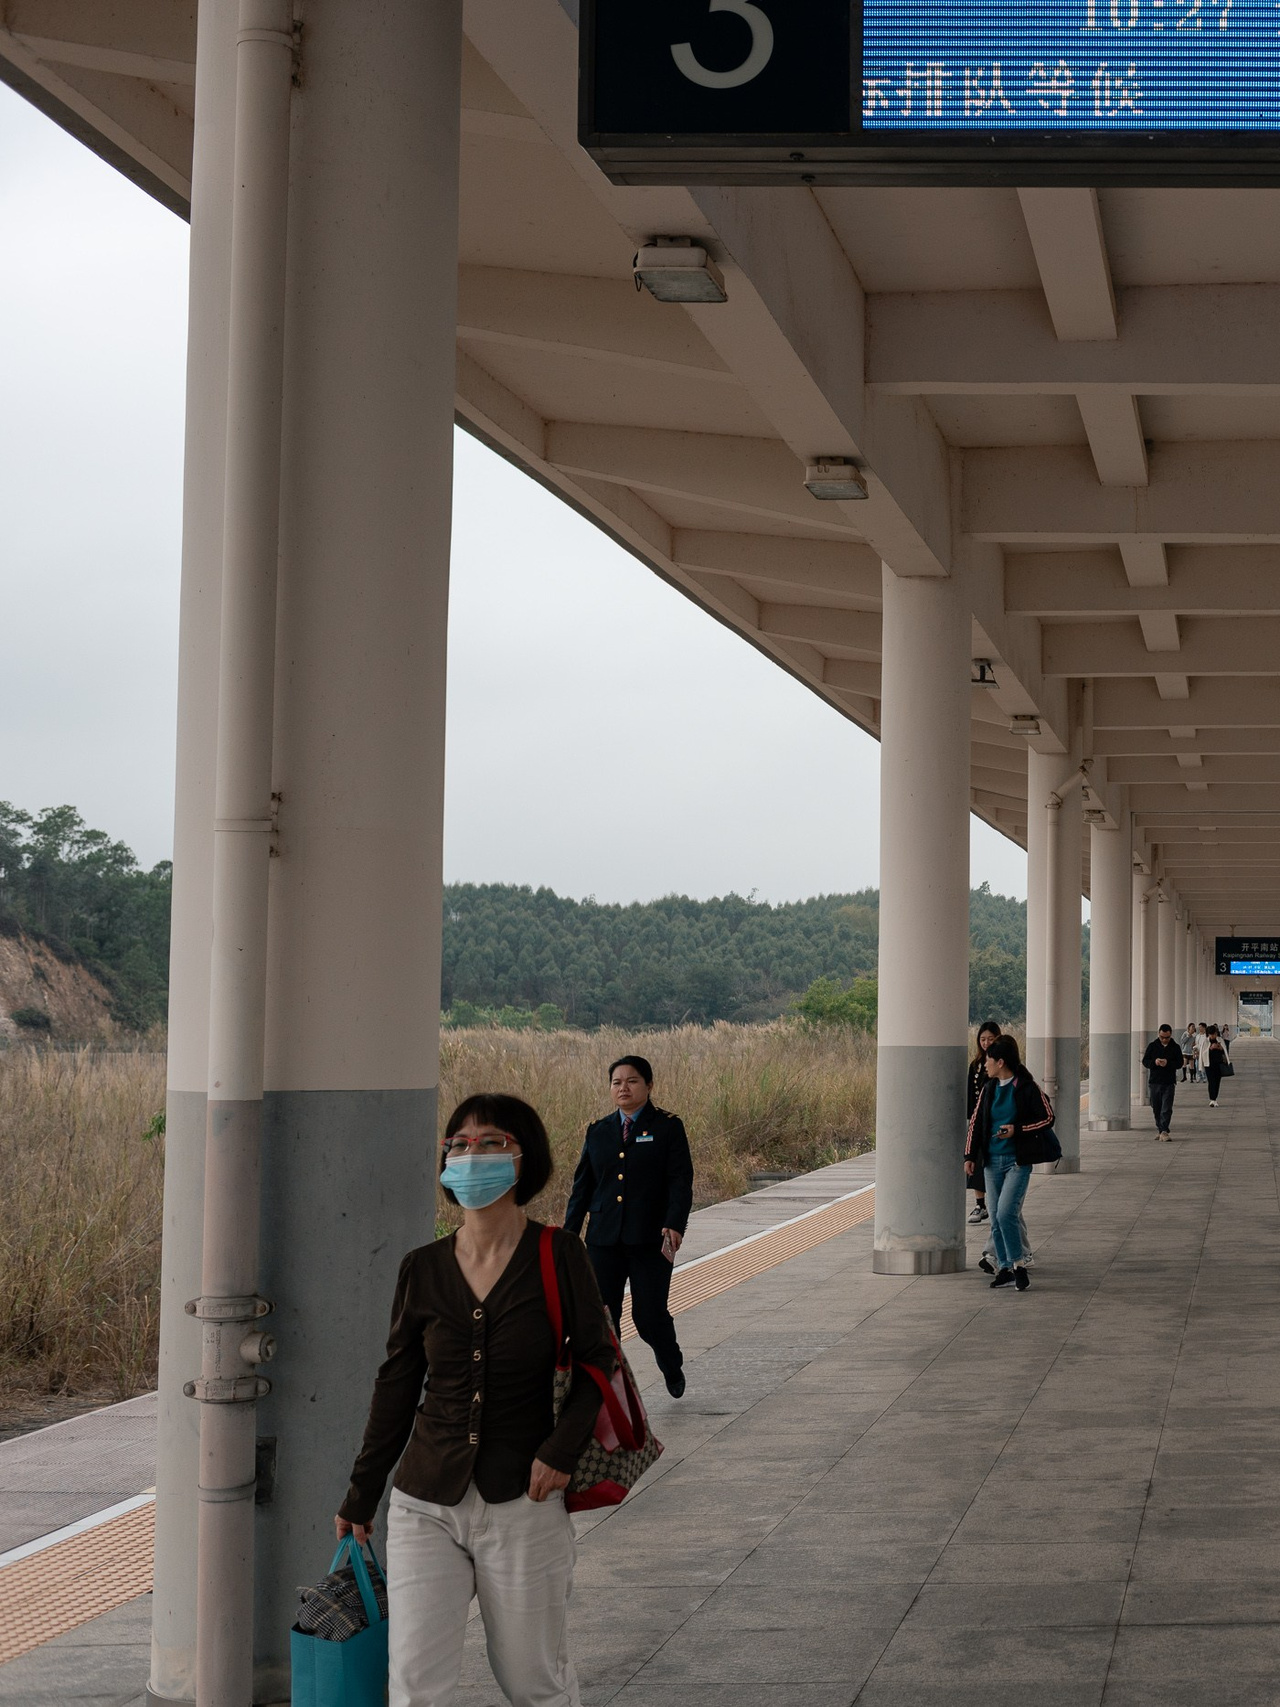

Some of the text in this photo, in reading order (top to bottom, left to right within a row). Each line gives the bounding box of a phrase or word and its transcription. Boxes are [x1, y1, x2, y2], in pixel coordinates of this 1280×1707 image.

[670, 0, 774, 89] 3
[1241, 943, 1279, 952] 开平南站
[1219, 962, 1227, 973] 3
[472, 1308, 483, 1320] C
[472, 1391, 481, 1403] A
[469, 1433, 478, 1444] E
